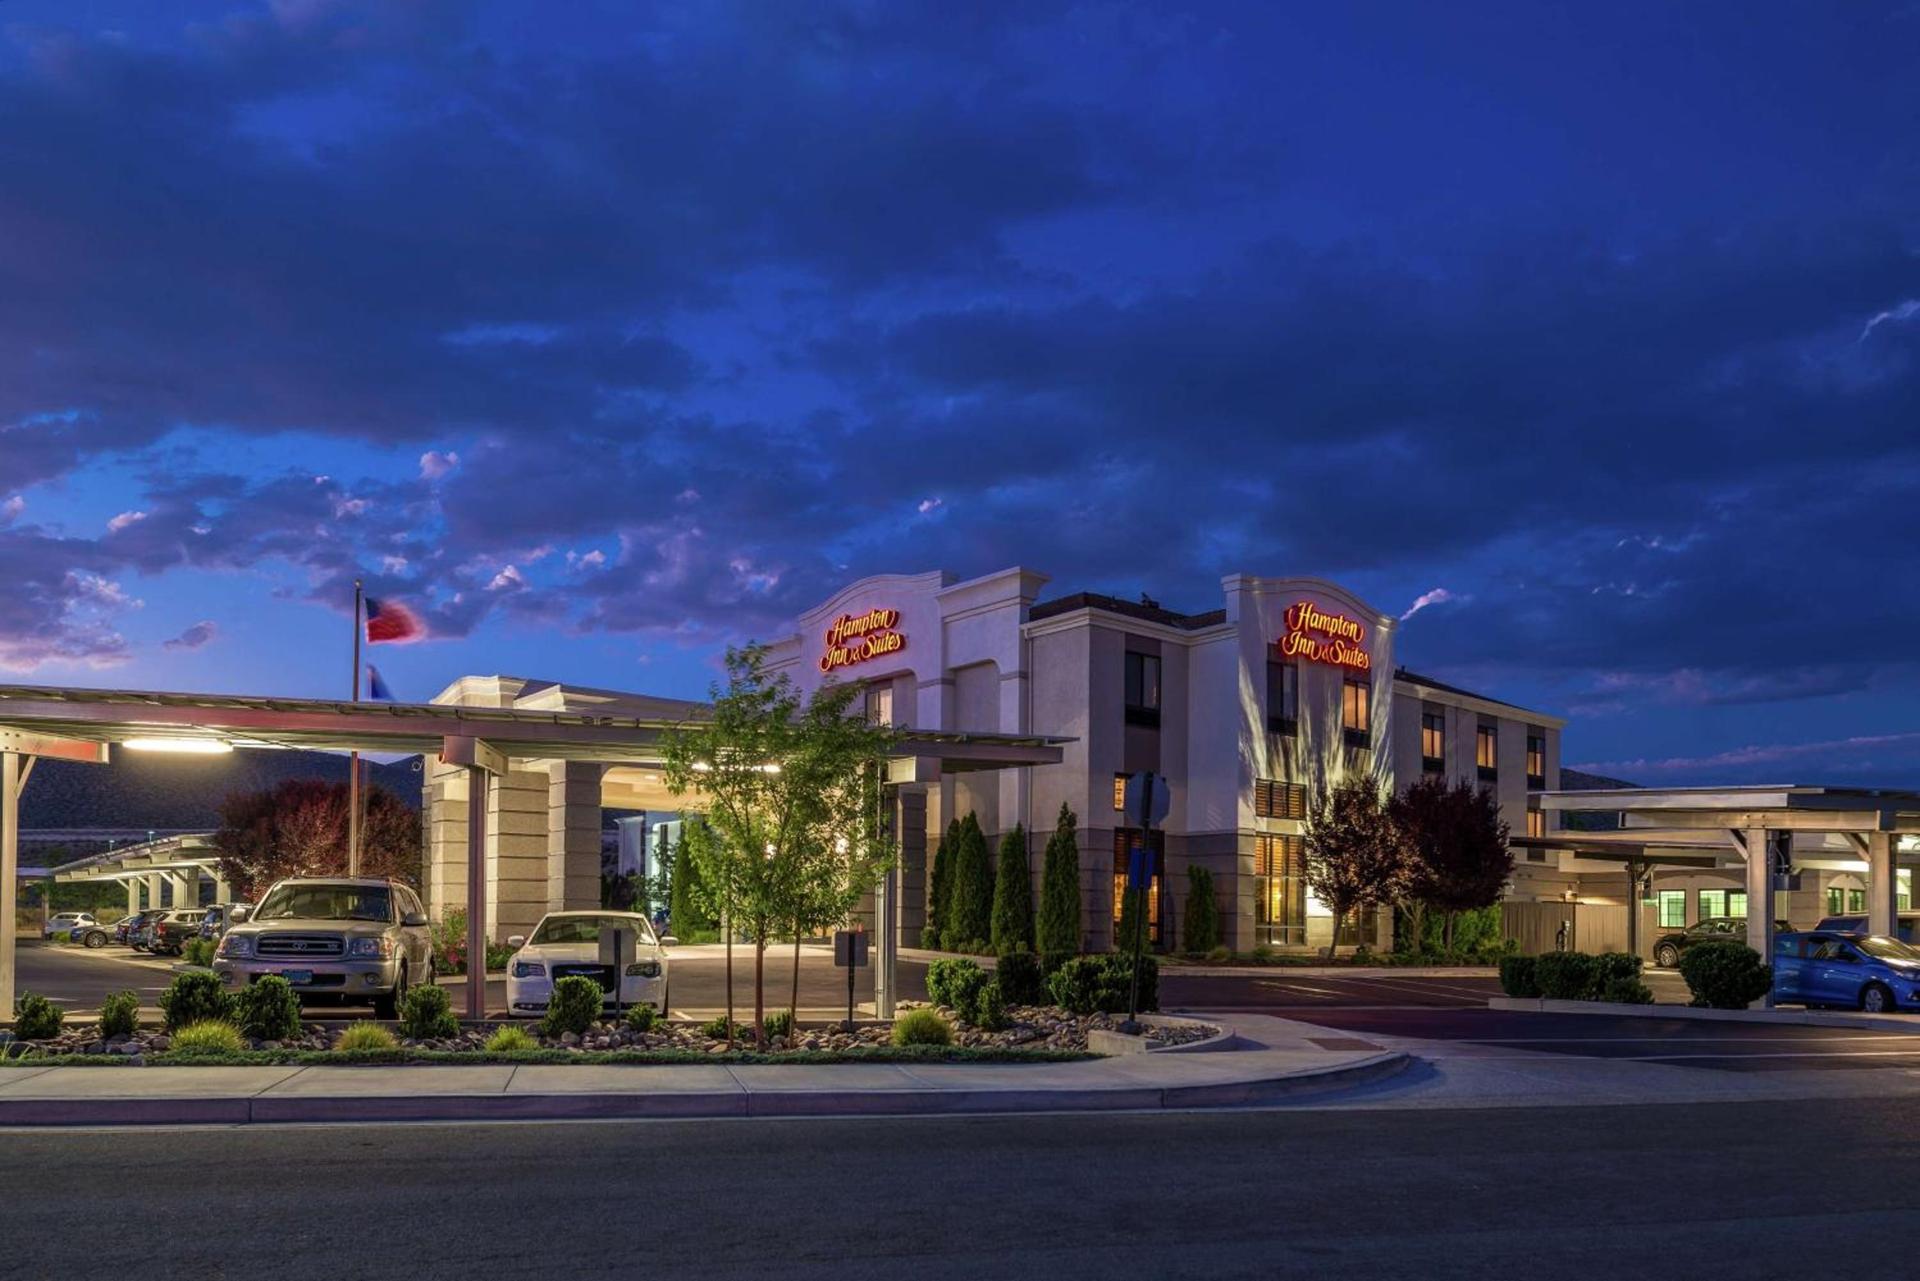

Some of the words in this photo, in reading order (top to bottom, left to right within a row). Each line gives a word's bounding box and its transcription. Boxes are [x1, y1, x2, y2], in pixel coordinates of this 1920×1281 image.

[825, 609, 898, 648] Hampton
[1287, 602, 1364, 643] Hampton
[819, 645, 853, 672] Inn
[860, 631, 903, 660] Suites
[1281, 631, 1321, 661] Inn
[1330, 640, 1370, 669] Suites
